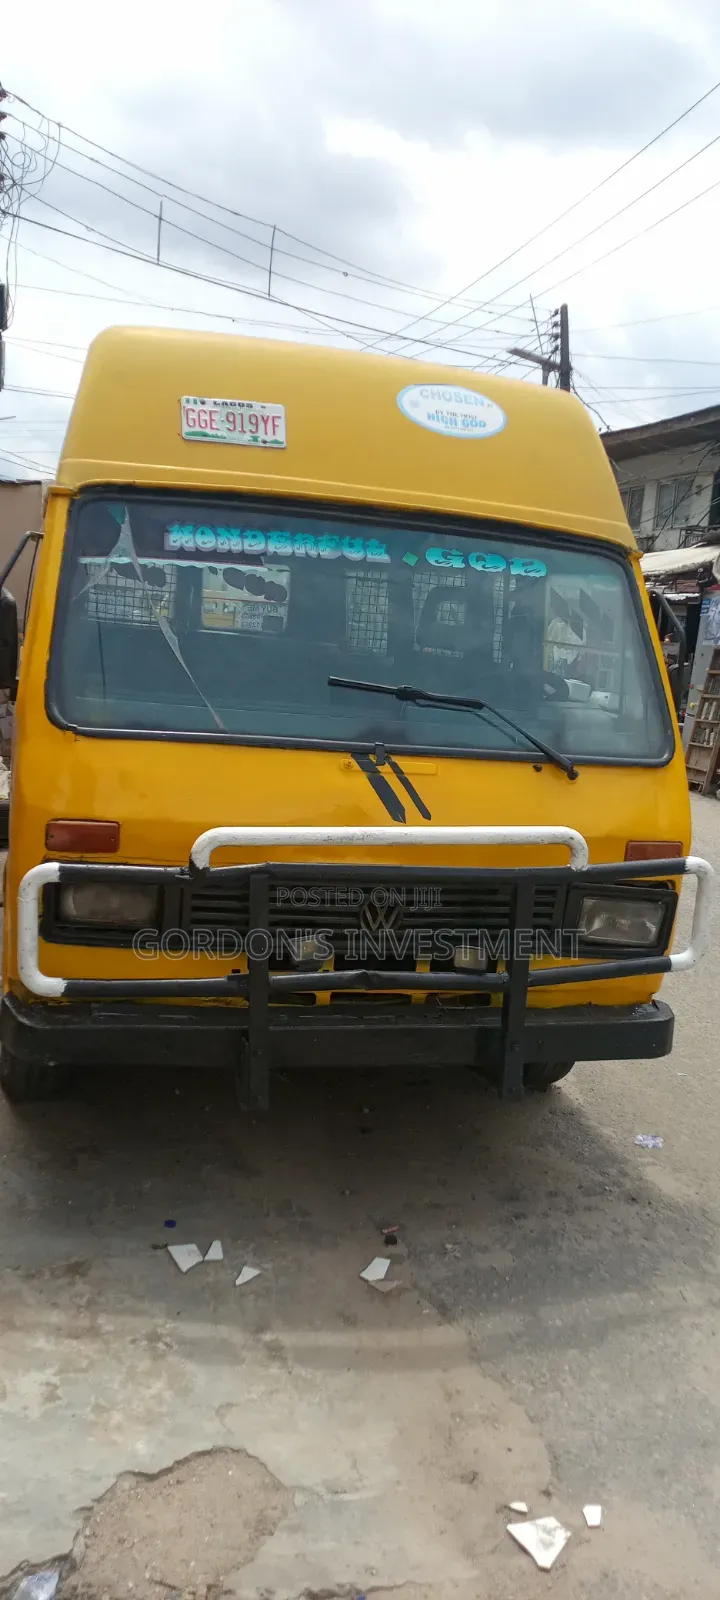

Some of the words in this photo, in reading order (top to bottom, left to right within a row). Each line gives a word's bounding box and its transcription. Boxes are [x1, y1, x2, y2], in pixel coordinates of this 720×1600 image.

[212, 400, 254, 409] LAGOS
[419, 388, 485, 407] CHOSEN
[184, 407, 282, 436] GGE-919YF
[427, 411, 458, 427] HIGH
[461, 418, 487, 428] GOD
[165, 522, 391, 563] WONDERFUL
[425, 547, 547, 578] GOD
